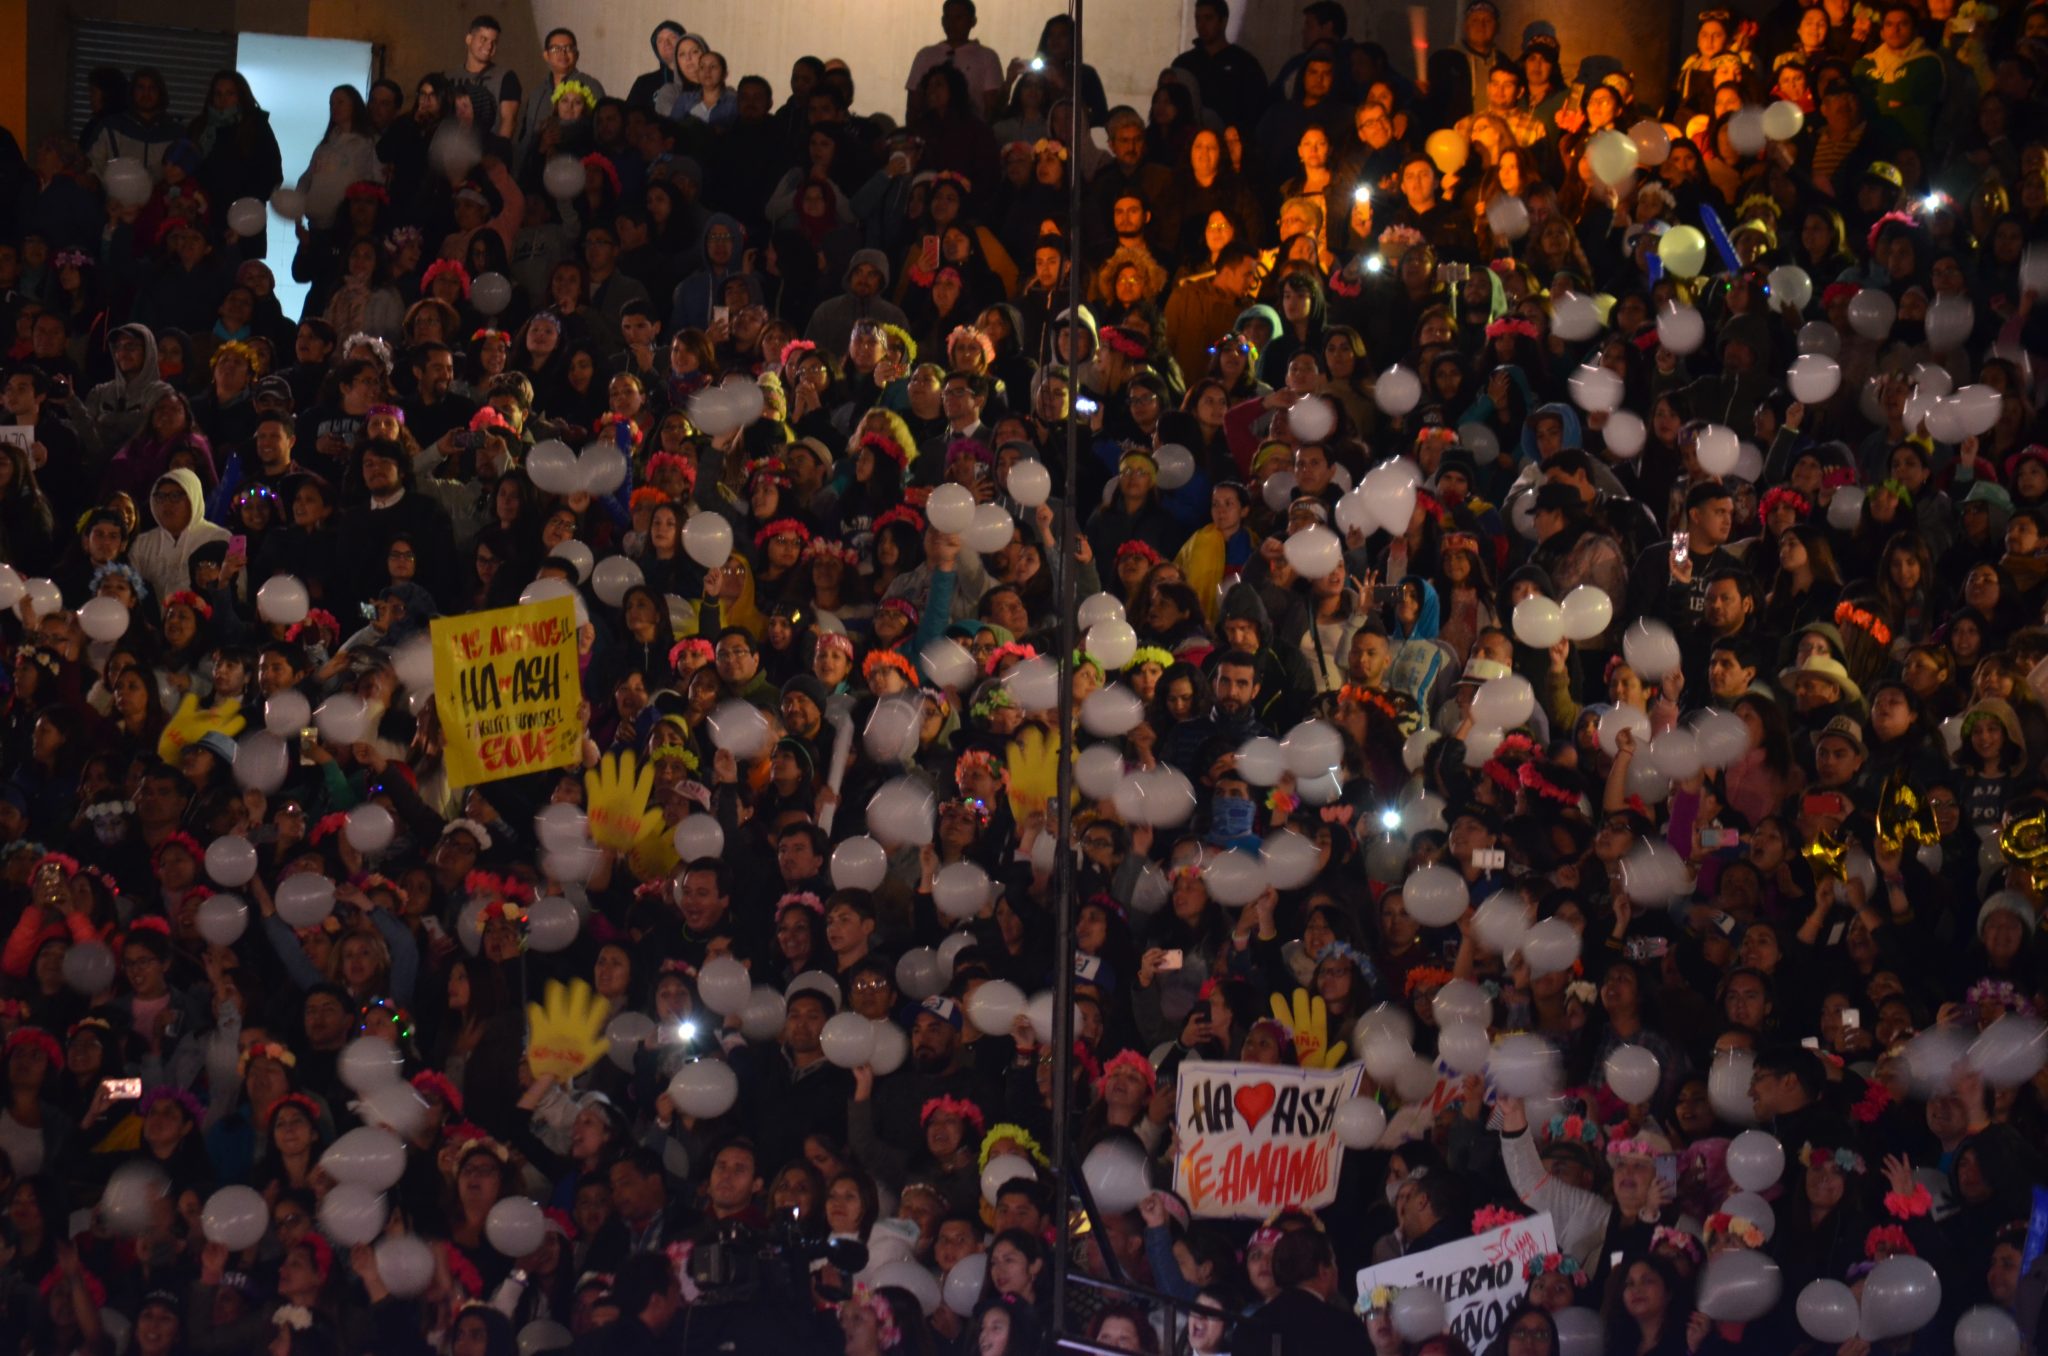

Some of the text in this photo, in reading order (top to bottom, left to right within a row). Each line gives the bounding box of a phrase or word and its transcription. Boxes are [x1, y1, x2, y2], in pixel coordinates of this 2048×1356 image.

[512, 653, 560, 703] ASH
[1188, 1078, 1345, 1138] HA ASH
[1215, 1130, 1336, 1207] AMAMOS
